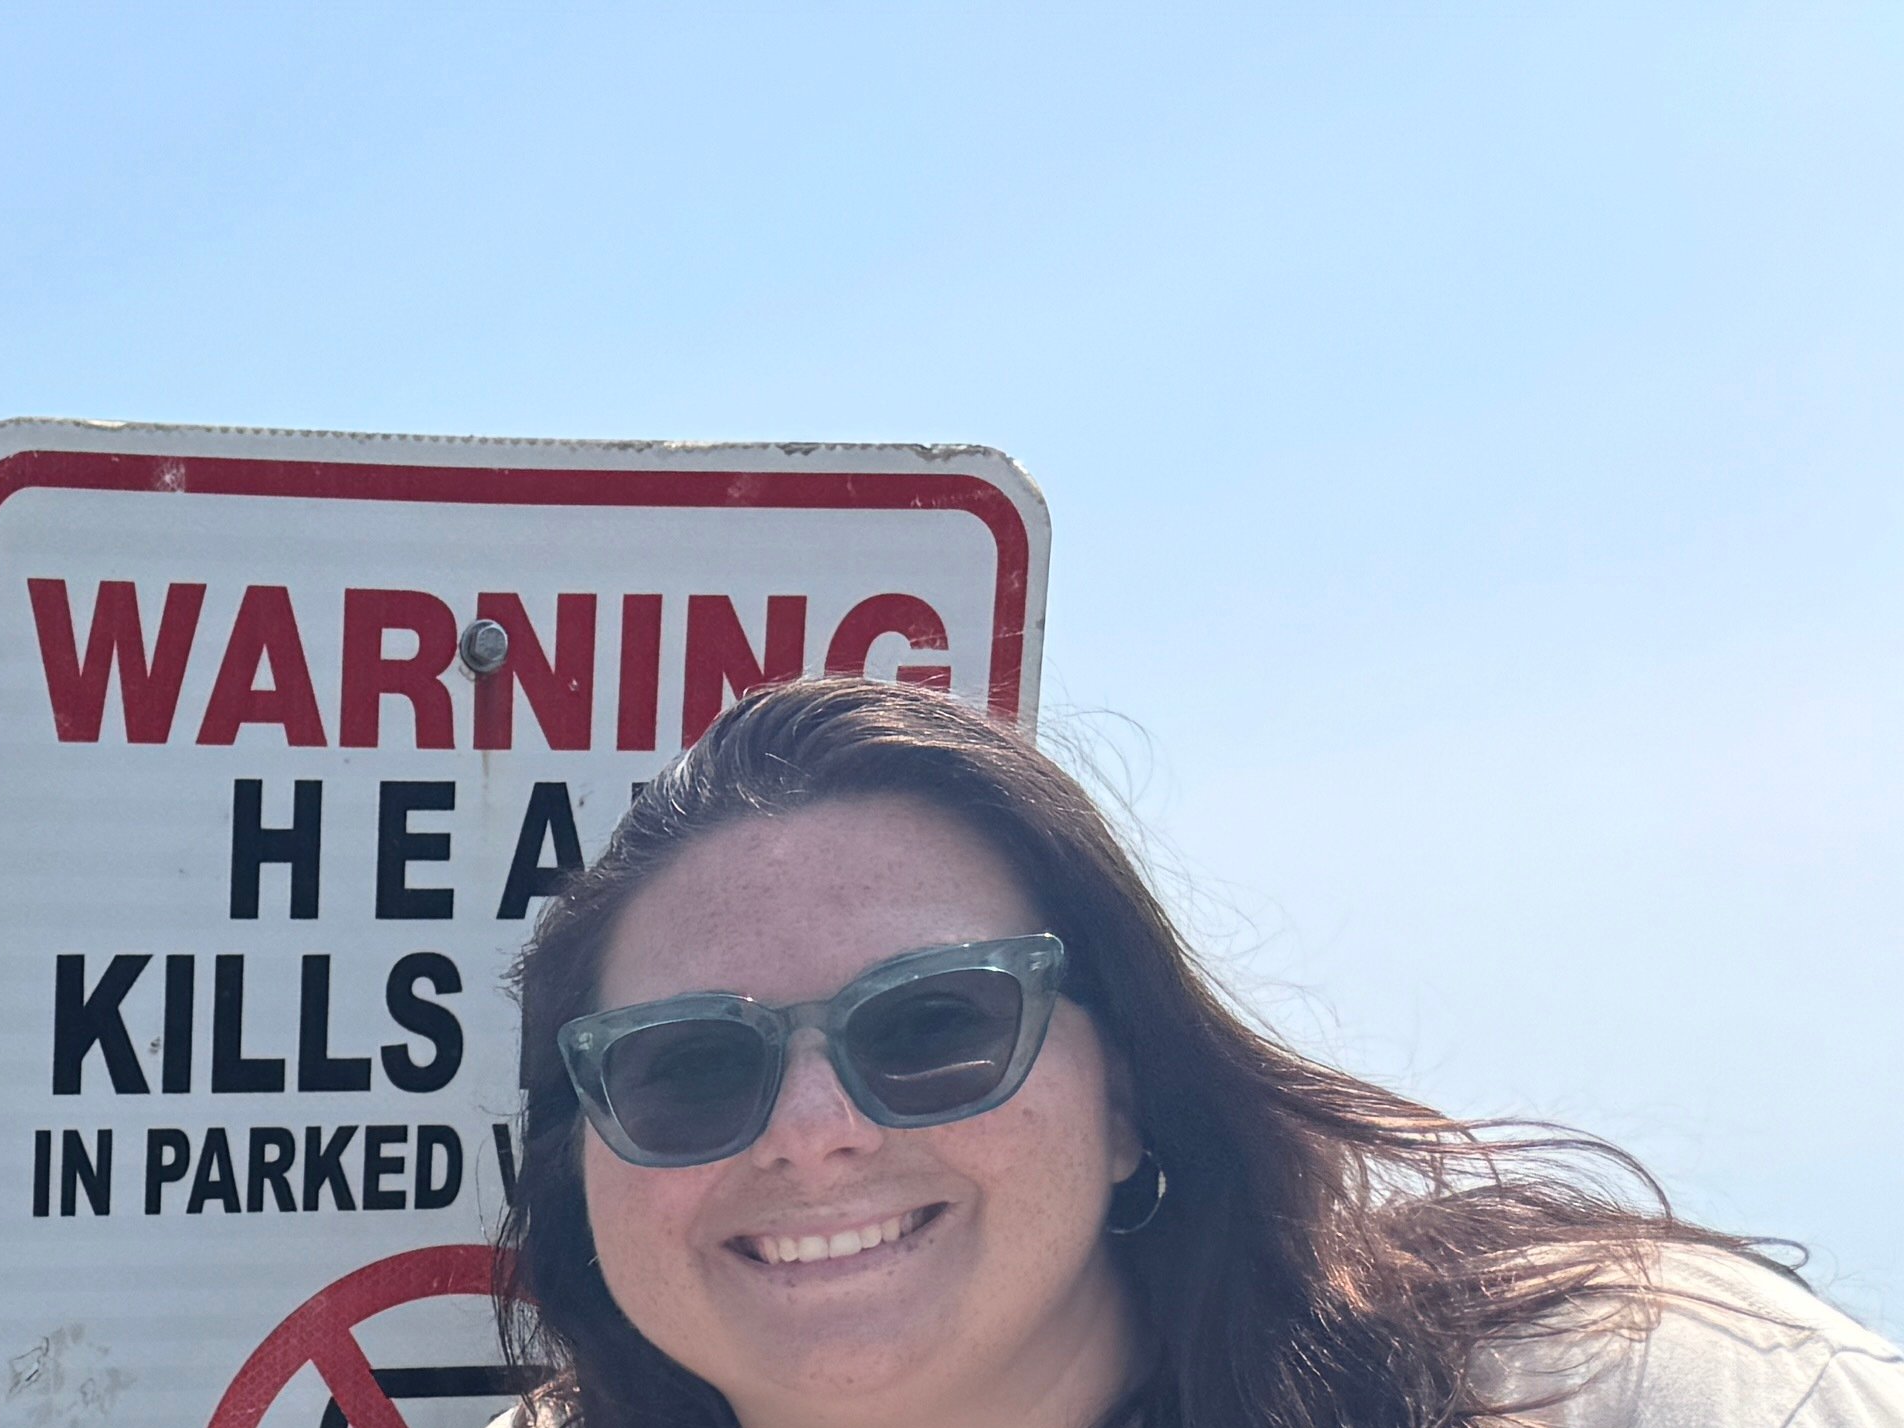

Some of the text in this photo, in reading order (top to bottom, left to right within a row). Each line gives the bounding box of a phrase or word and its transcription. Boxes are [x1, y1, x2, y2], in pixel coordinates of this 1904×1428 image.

[53, 952, 463, 1095] KILLS
[33, 1129, 112, 1217] IN
[145, 1125, 463, 1215] PARKED
